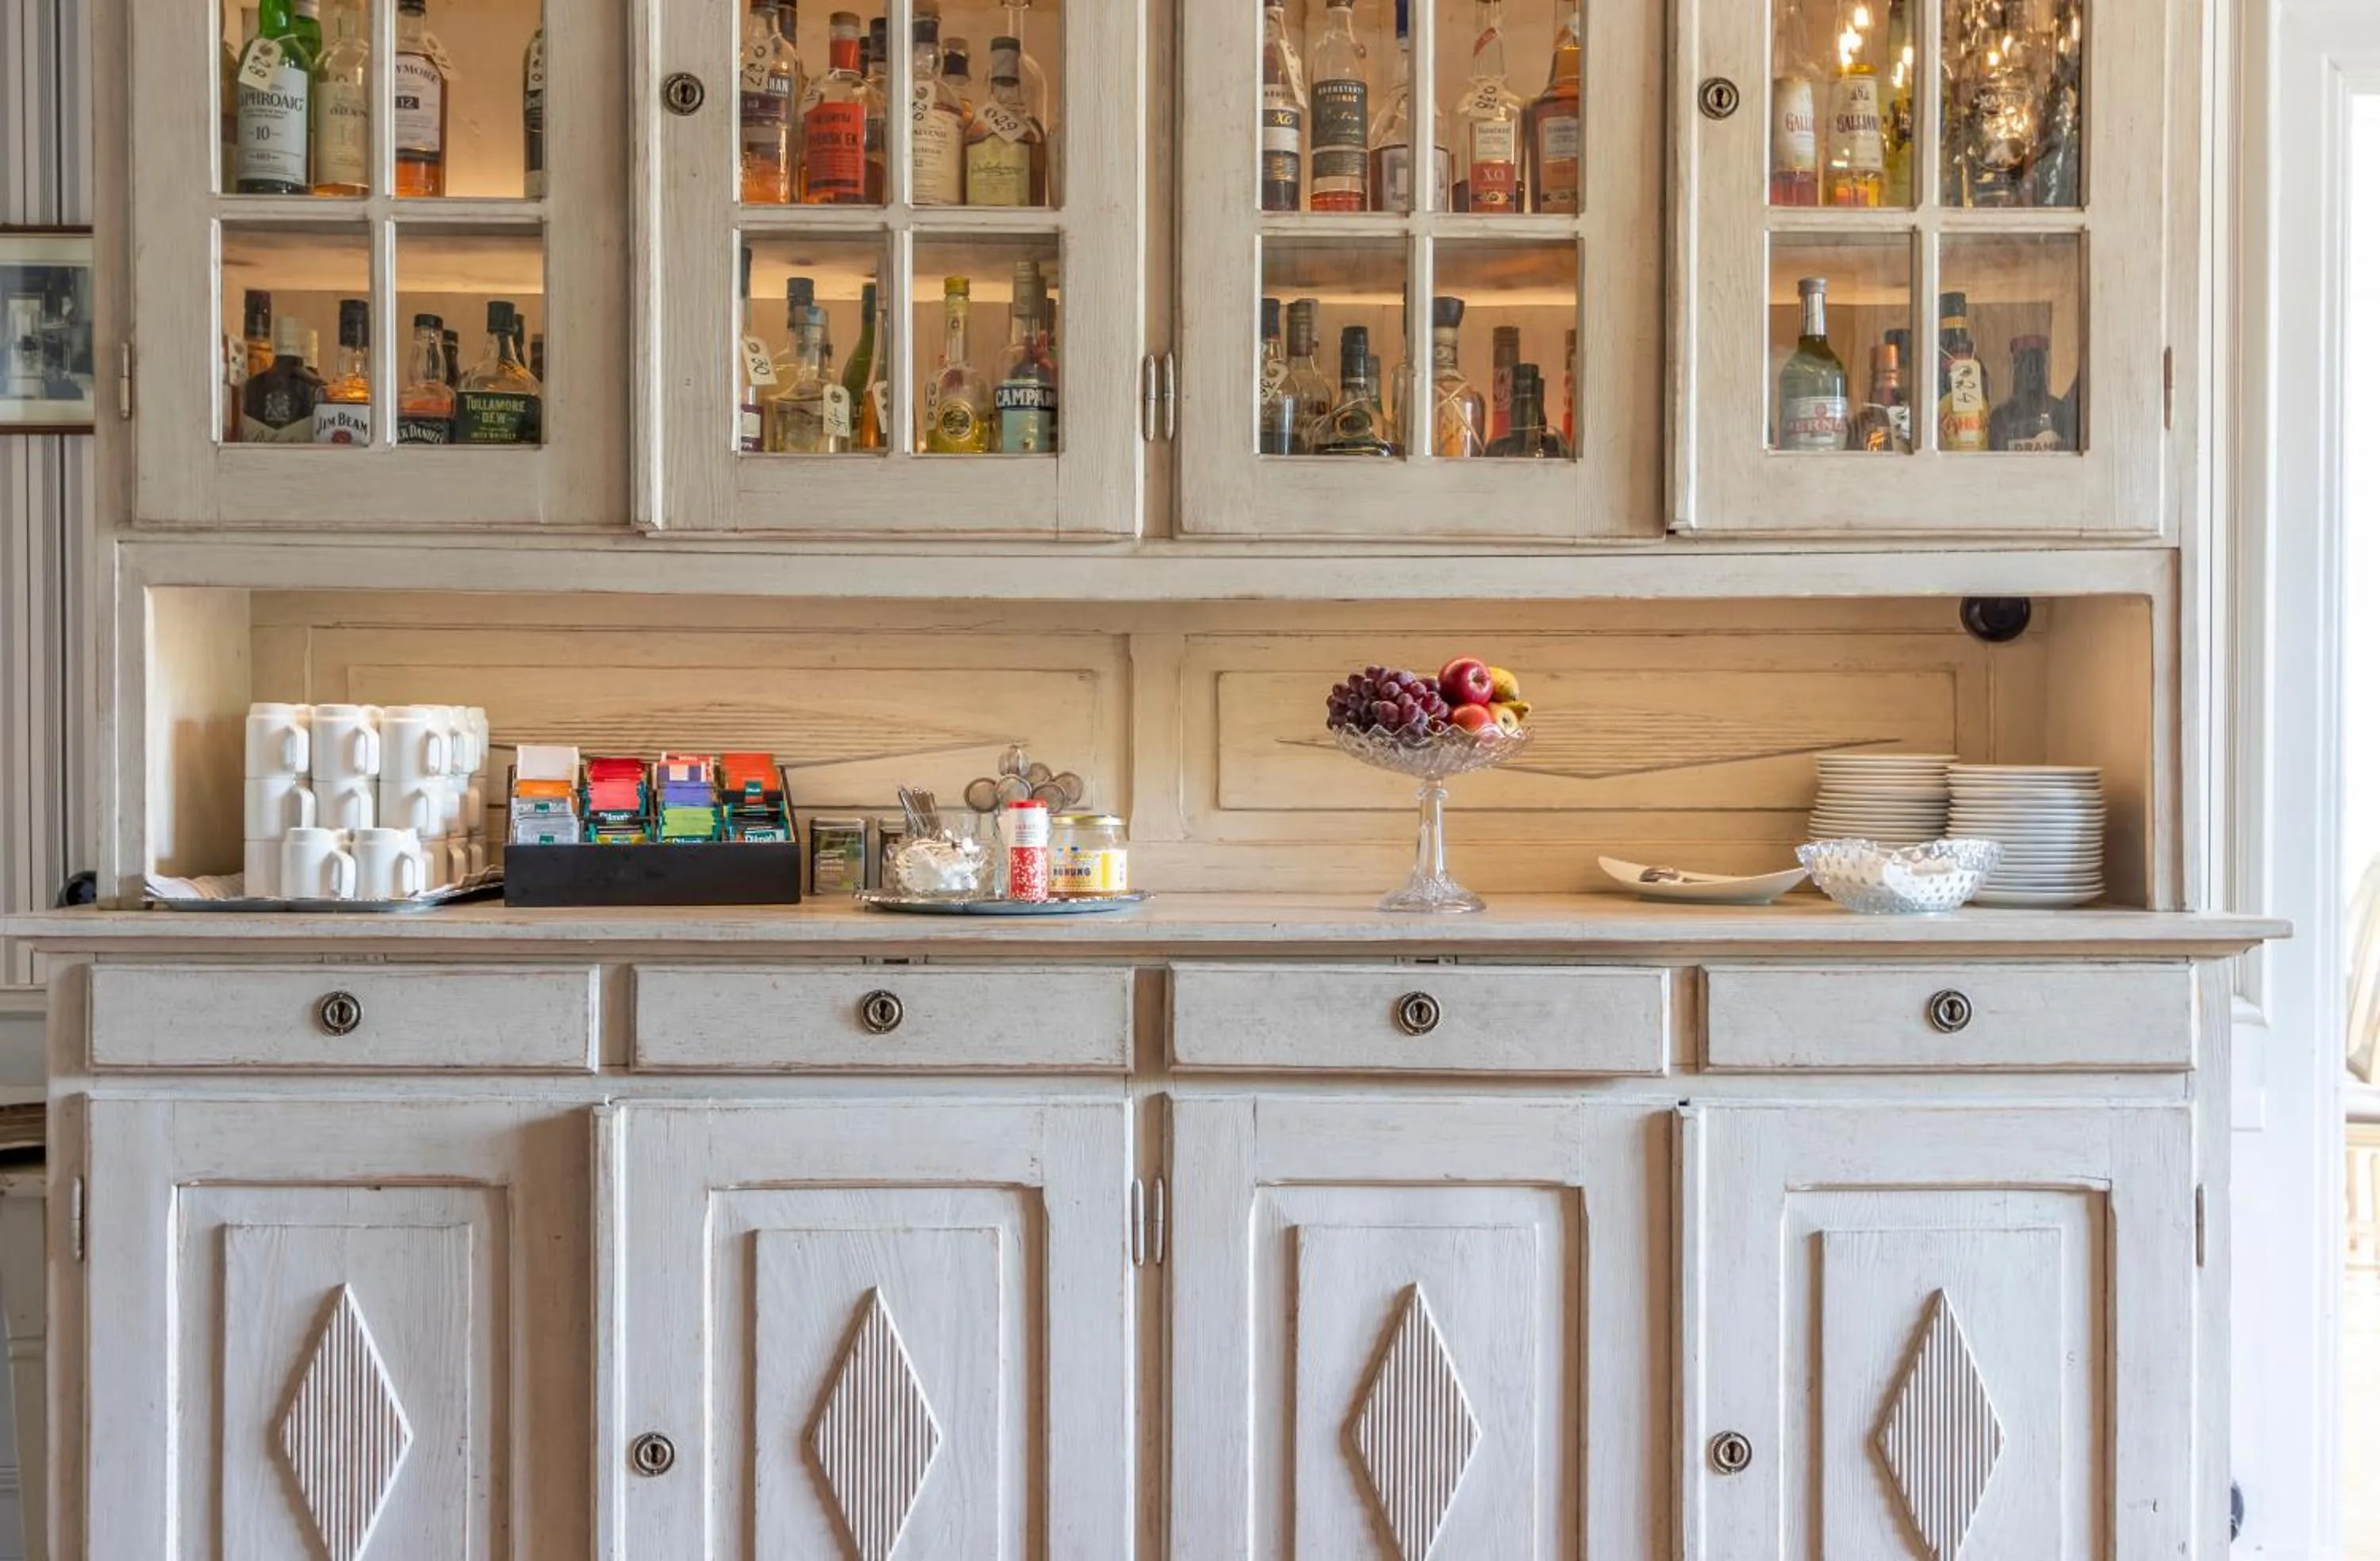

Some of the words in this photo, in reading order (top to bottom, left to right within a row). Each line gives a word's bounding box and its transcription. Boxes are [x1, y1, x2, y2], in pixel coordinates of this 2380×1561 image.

[255, 126, 271, 140] 10
[465, 395, 525, 412] TULLAMORE
[317, 416, 336, 435] JIM
[338, 412, 368, 436] BEAM
